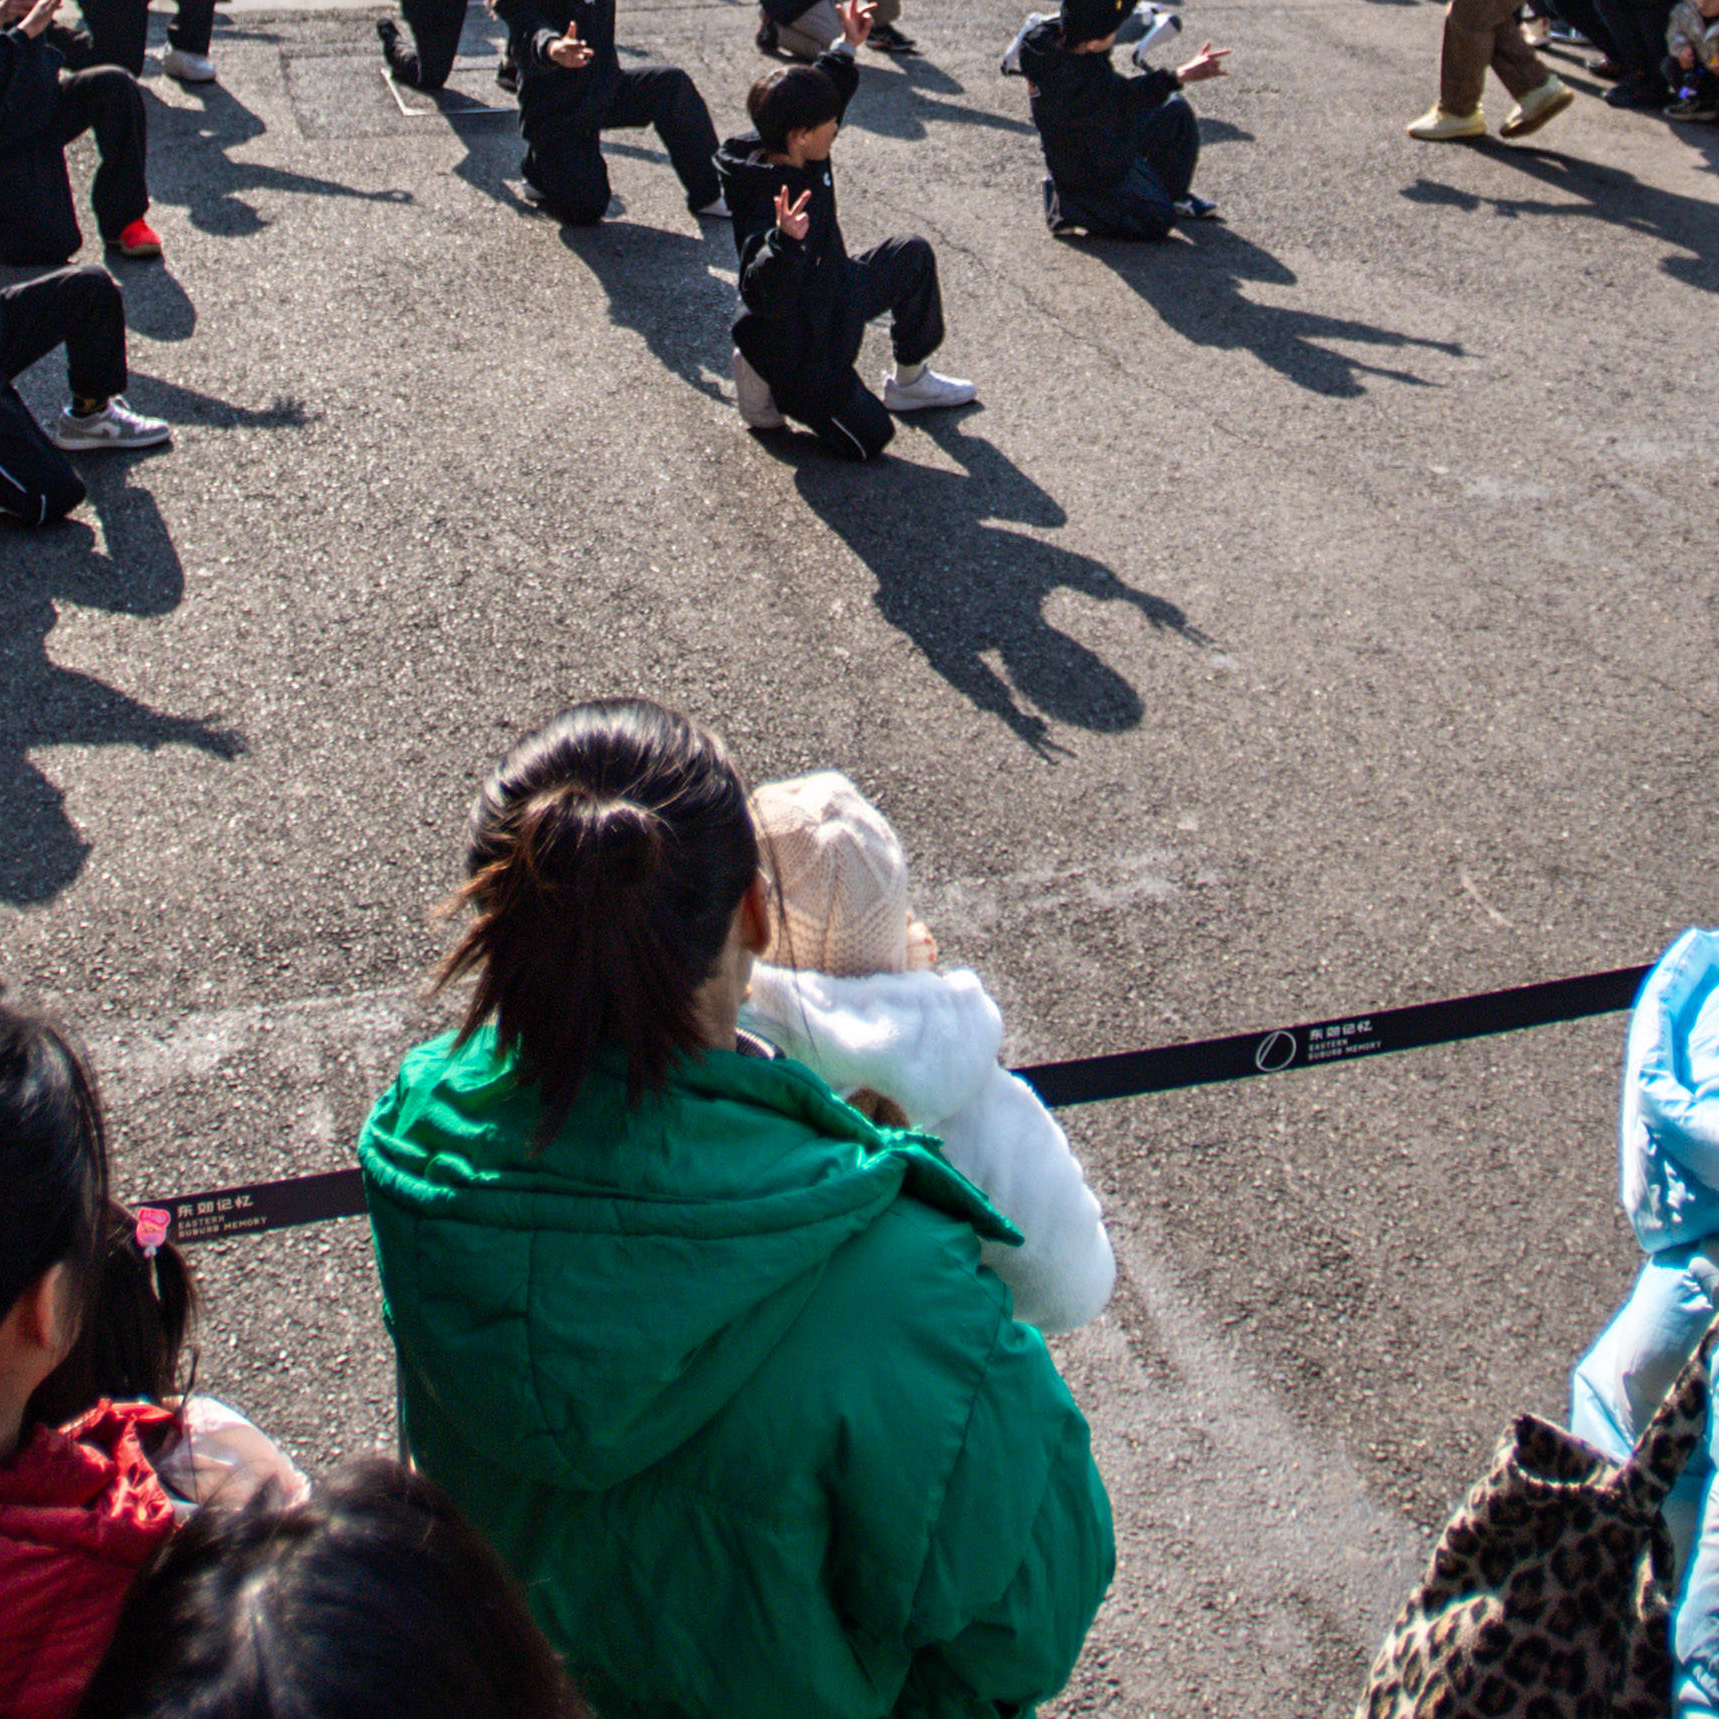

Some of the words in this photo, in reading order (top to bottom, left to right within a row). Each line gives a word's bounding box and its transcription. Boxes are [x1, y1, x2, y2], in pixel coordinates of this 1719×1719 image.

[177, 1194, 254, 1218] 东郊记忆
[177, 1224, 220, 1239] SUBURB
[223, 1216, 267, 1231] MEMORY
[178, 1214, 225, 1229] EASTERN
